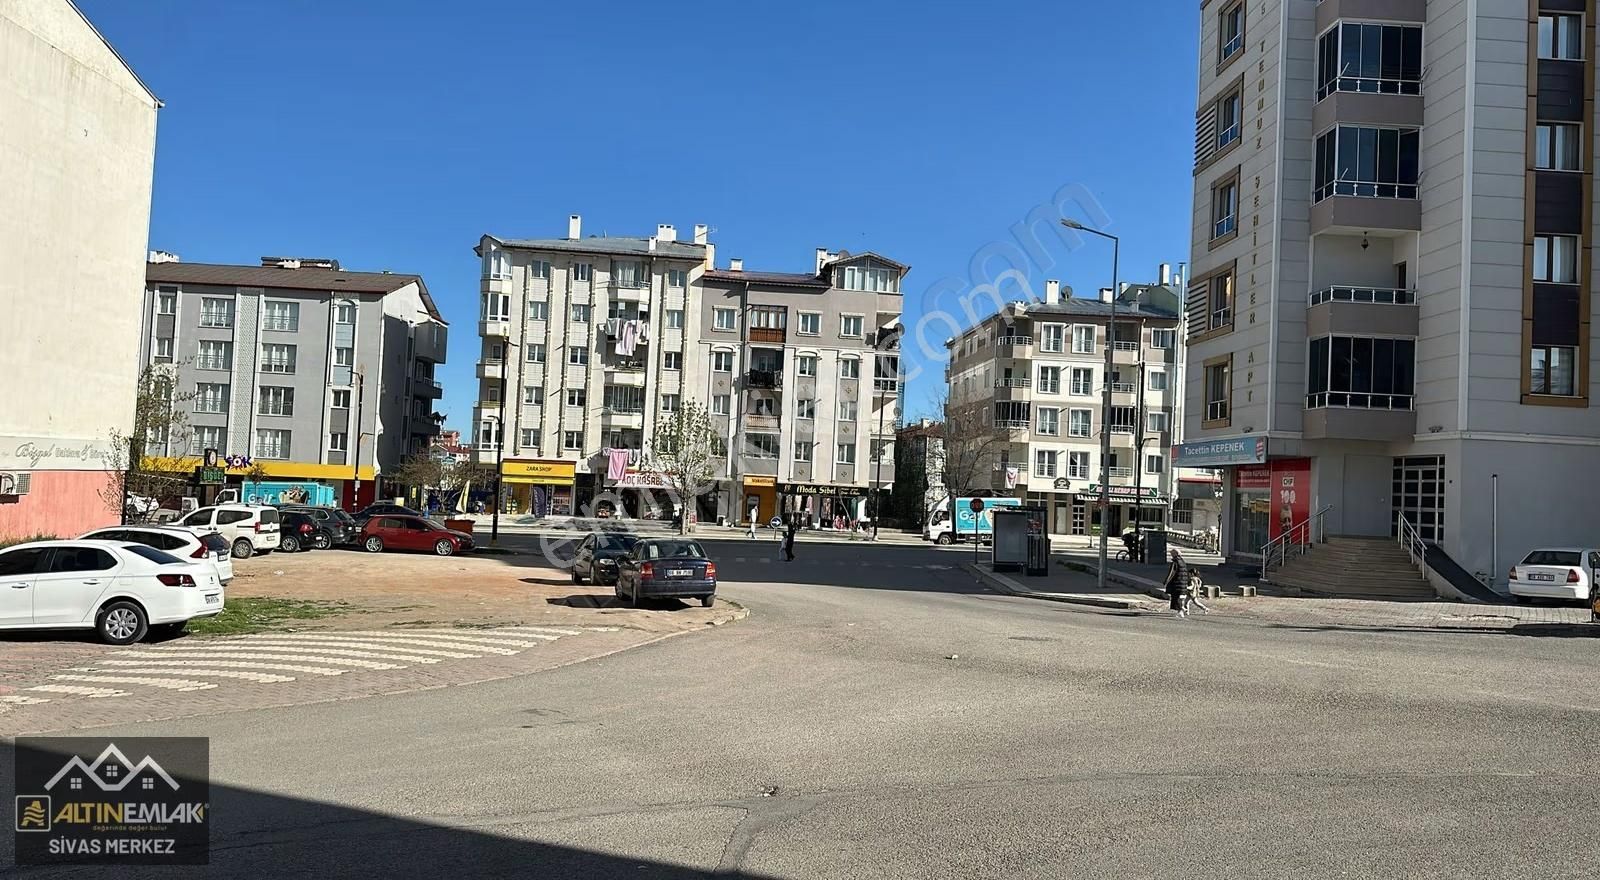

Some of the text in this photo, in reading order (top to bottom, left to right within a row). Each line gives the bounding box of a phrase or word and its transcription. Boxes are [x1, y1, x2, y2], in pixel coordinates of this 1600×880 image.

[1247, 351, 1255, 403] APT
[1184, 442, 1245, 455] Tacettin KEPENEK
[796, 484, 817, 494] Moda
[819, 485, 836, 495] Sibel
